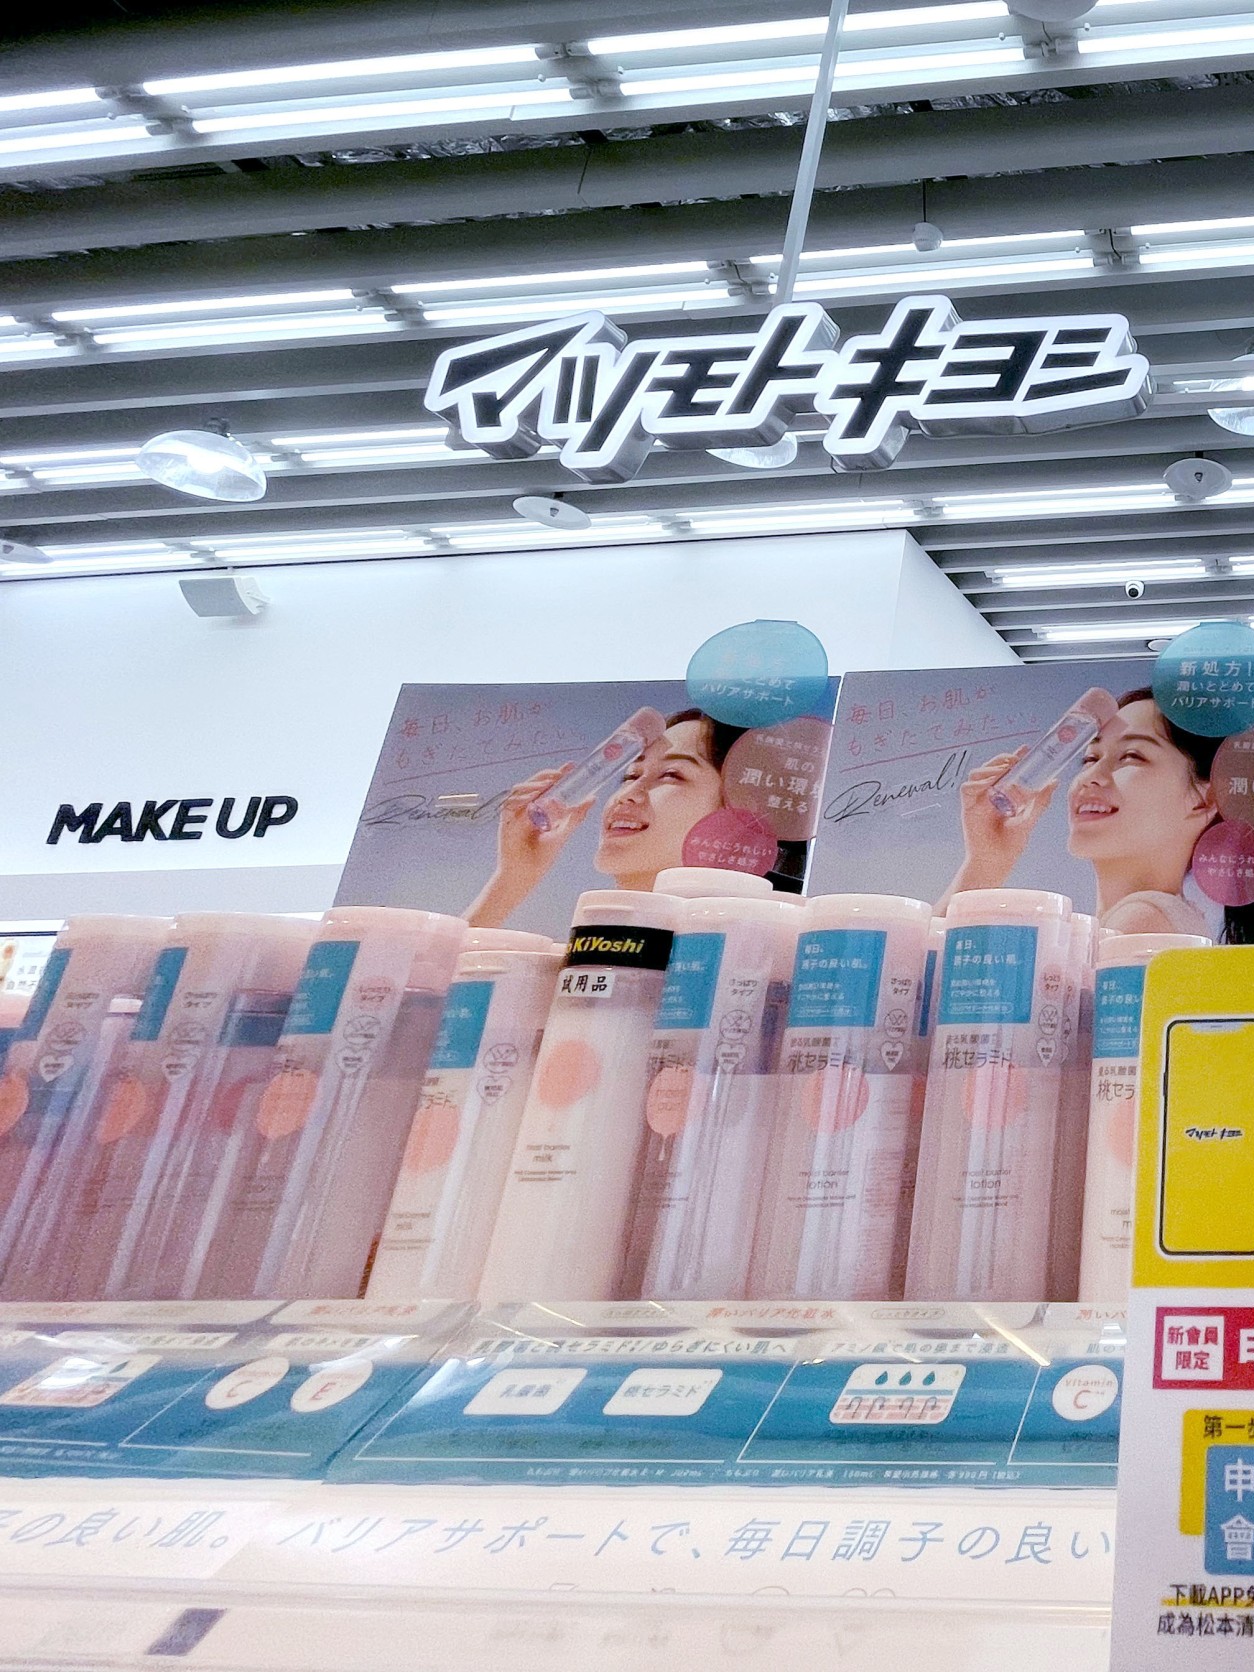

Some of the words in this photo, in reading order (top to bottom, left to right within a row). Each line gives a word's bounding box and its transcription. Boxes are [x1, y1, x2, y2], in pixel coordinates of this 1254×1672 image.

[46, 799, 213, 844] MAKE
[216, 796, 298, 839] UP
[560, 973, 608, 993] 試用品
[1167, 1323, 1219, 1346] 新會員
[1175, 1349, 1211, 1371] 限定
[1065, 1377, 1114, 1387] Vitamin
[1073, 1389, 1092, 1409] C
